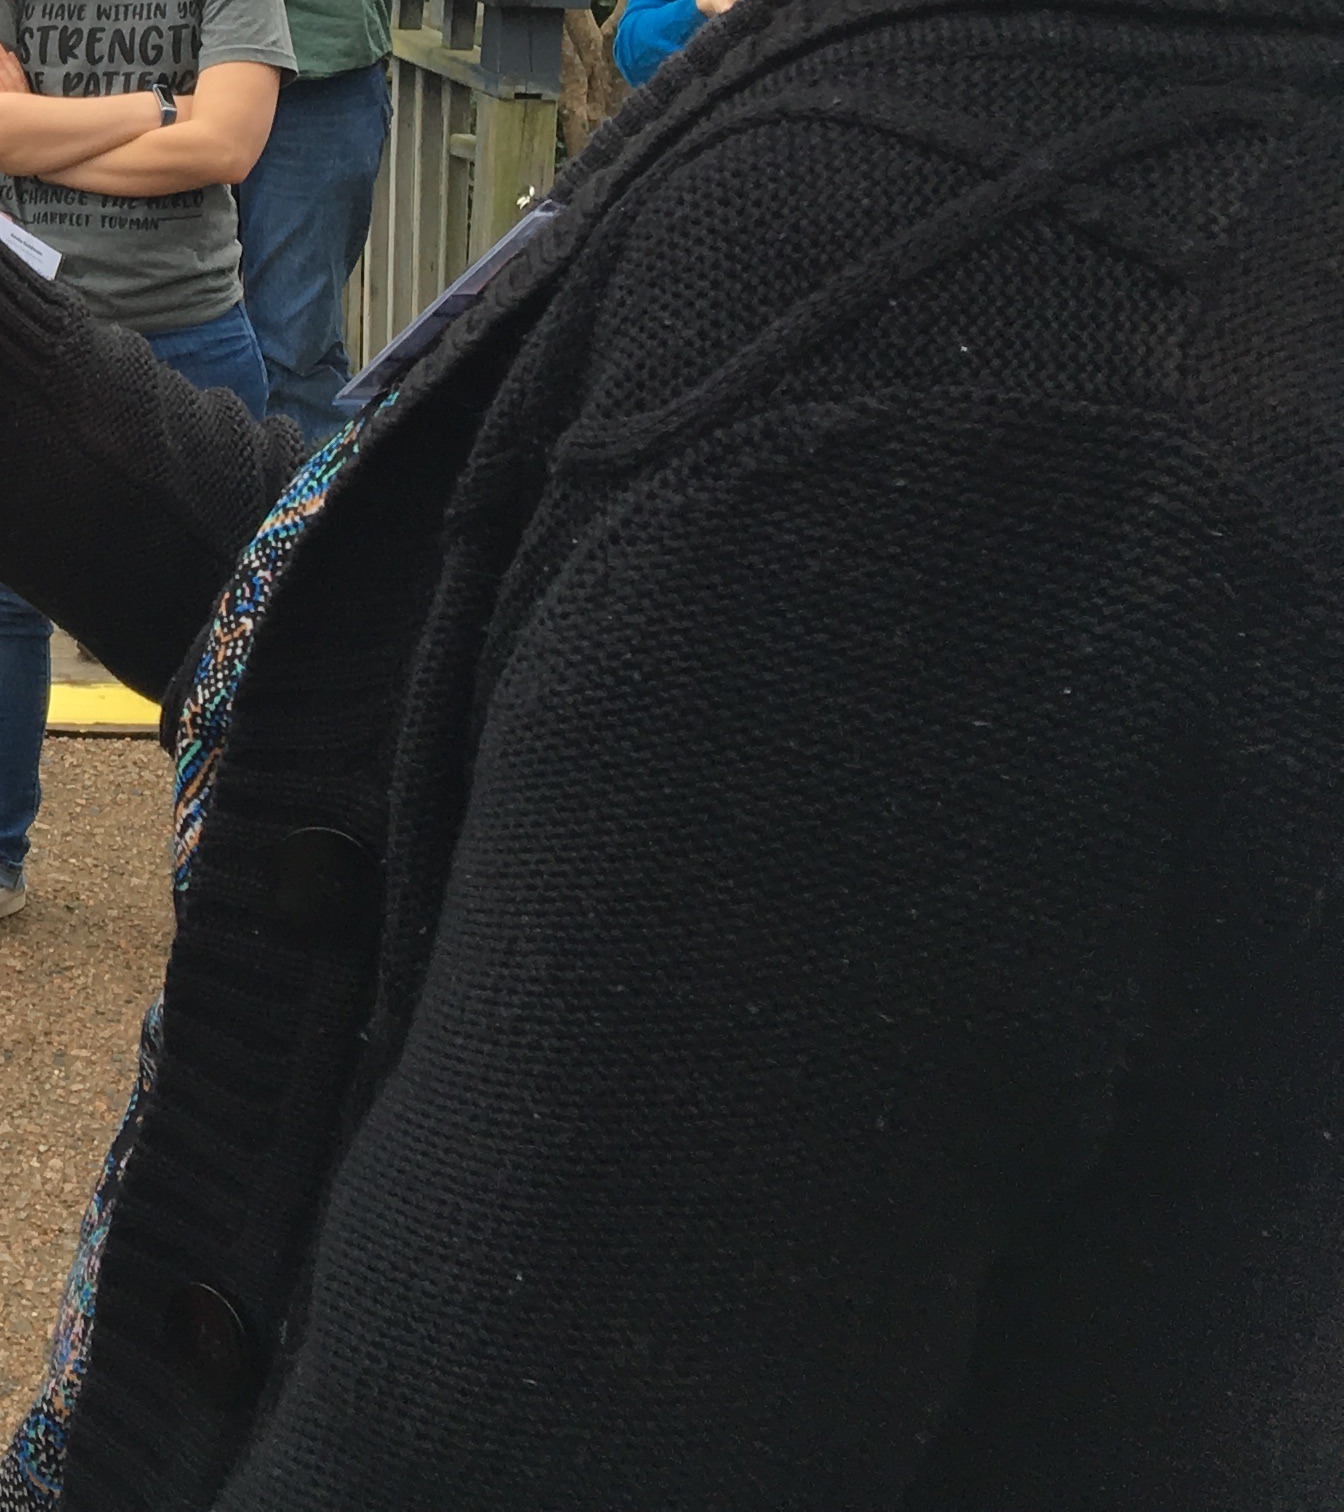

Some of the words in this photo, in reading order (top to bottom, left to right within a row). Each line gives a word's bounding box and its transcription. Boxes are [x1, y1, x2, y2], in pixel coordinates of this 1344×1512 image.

[42, 2, 87, 21] HAVE
[96, 2, 167, 21] WITHIN
[22, 187, 88, 206] CHANGE
